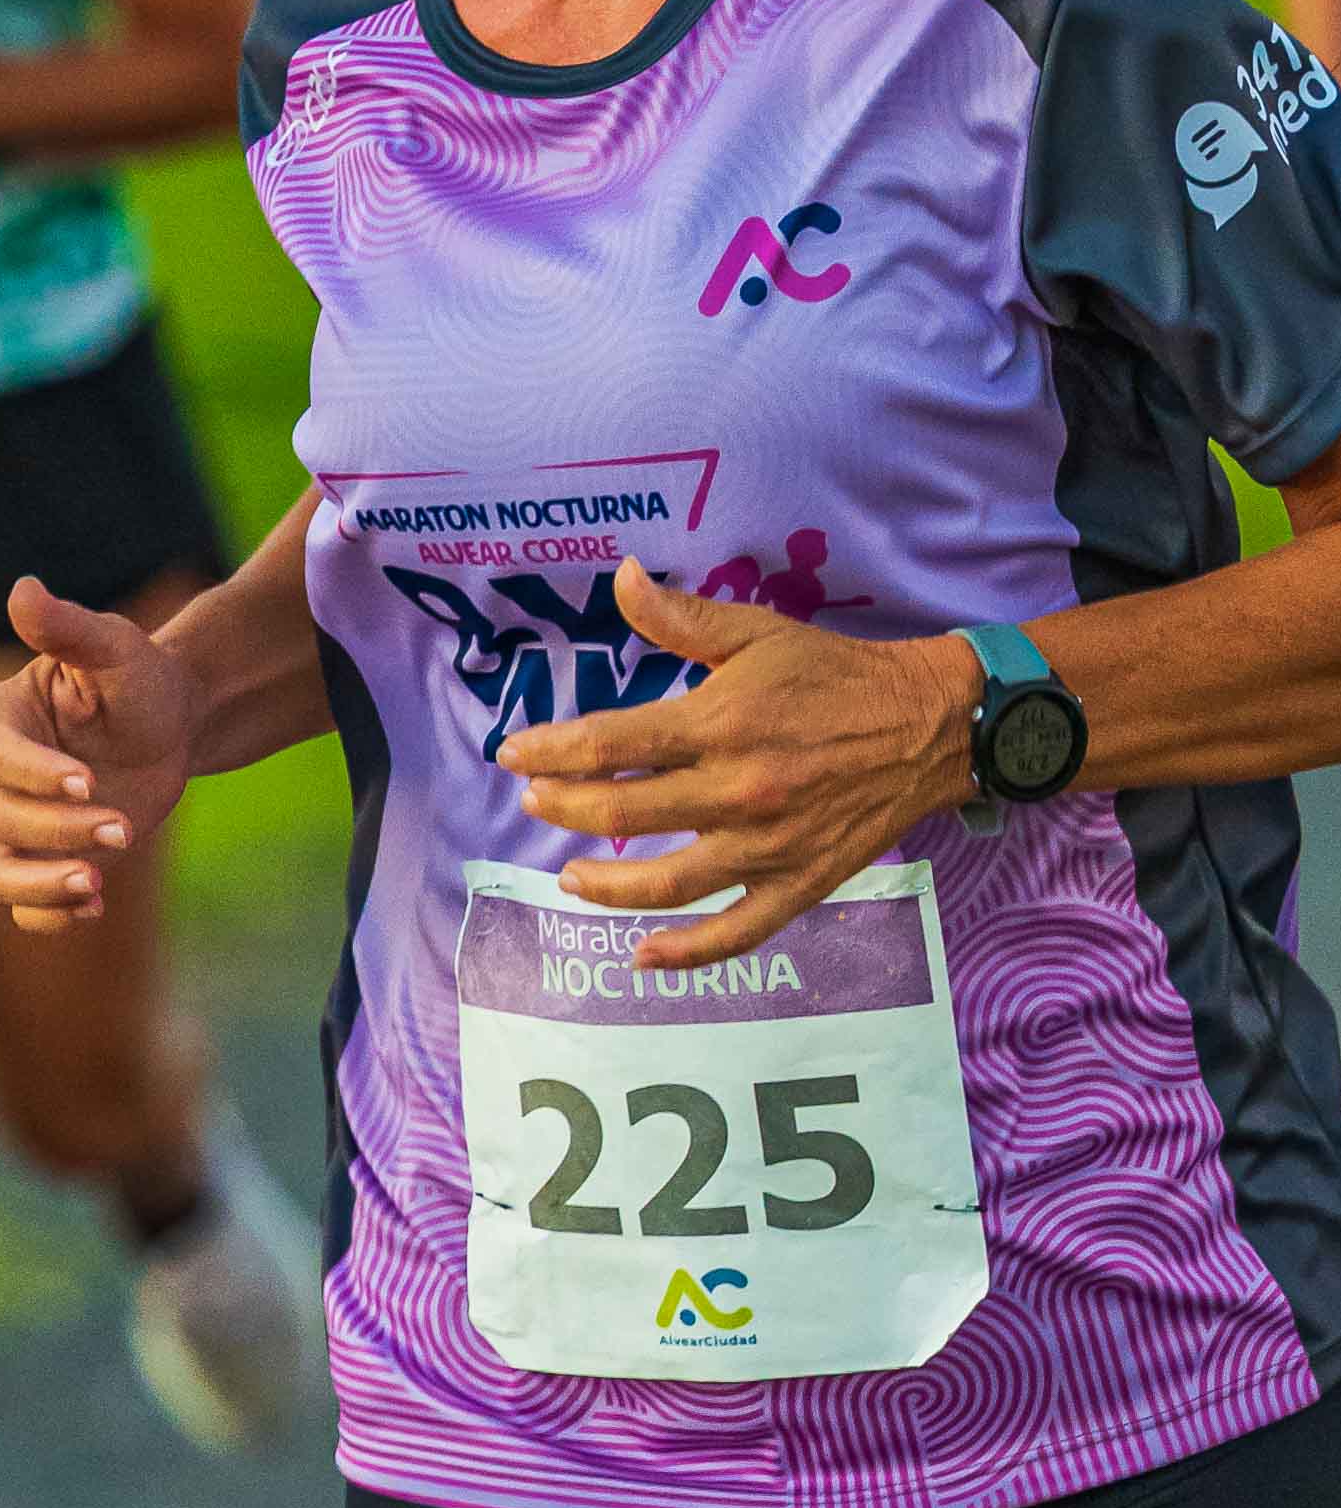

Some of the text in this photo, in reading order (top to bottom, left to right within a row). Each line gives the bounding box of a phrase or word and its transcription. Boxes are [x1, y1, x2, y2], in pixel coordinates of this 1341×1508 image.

[698, 202, 851, 317] AC
[355, 491, 670, 534] MARATON NOCTURNA
[417, 534, 624, 567] ALVEAR CORRE
[538, 911, 670, 956] Marató
[541, 951, 804, 999] NOCTURNA
[518, 1073, 876, 1238] 225
[655, 1267, 754, 1330] AC
[659, 1333, 758, 1348] AlvearCiudad
